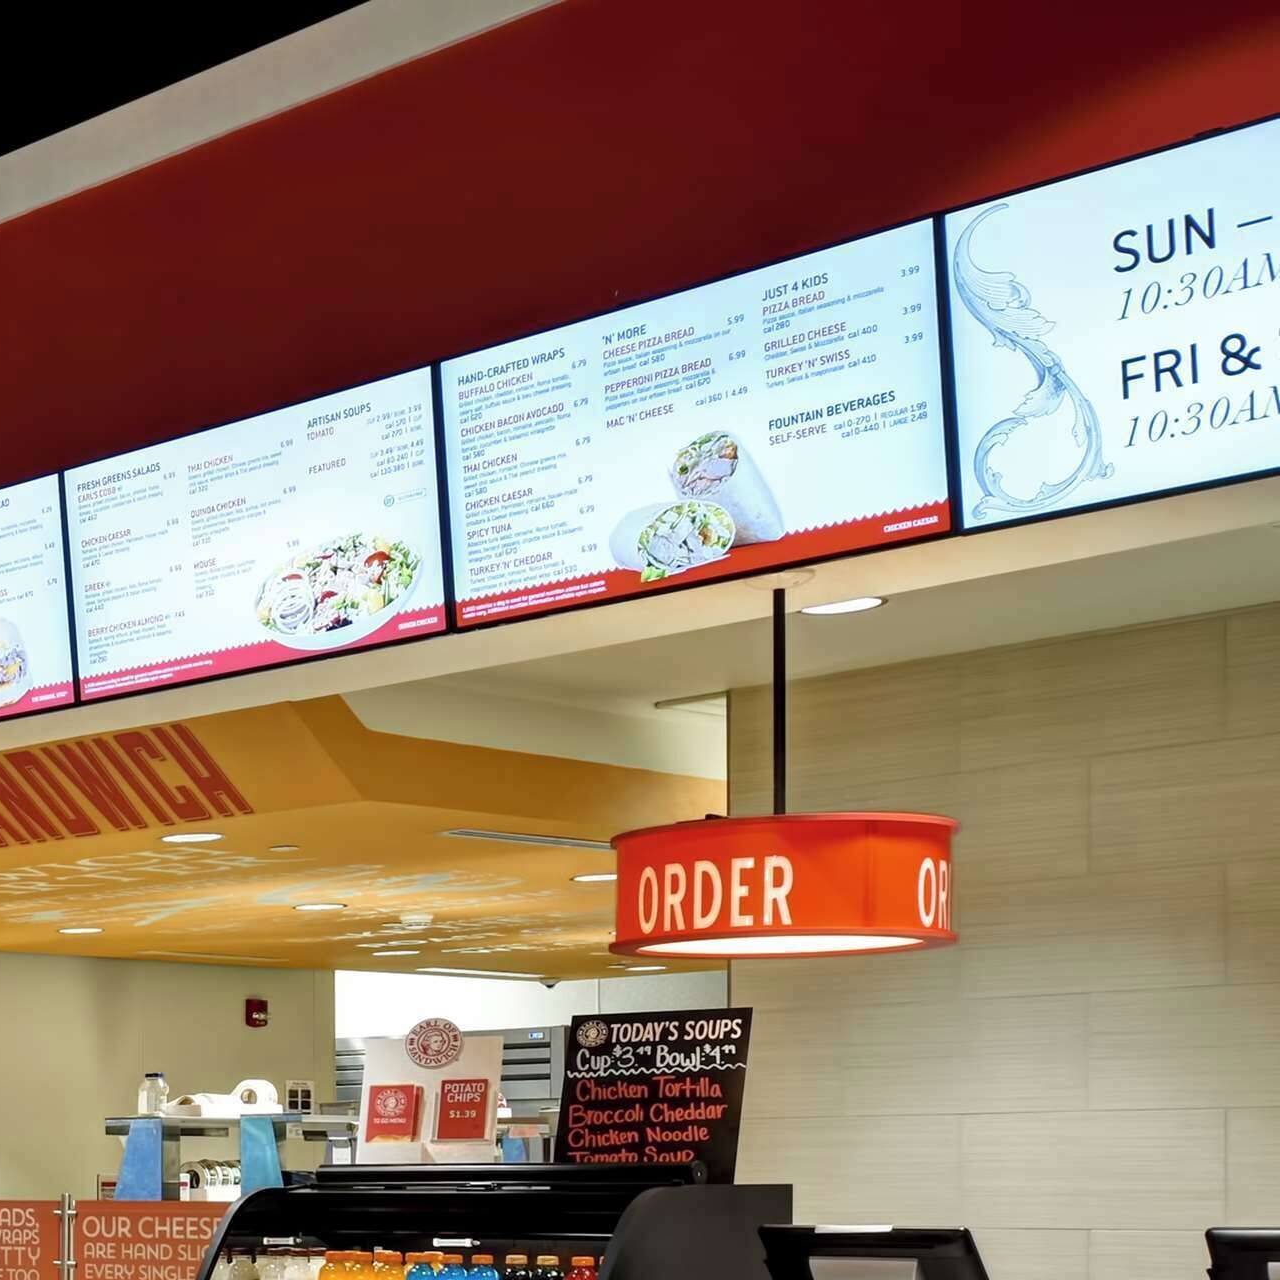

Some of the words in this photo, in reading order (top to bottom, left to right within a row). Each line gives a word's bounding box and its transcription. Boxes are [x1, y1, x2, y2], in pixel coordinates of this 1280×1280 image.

[1112, 206, 1216, 273] SUN
[762, 284, 788, 301] JUST
[791, 282, 799, 292] 4
[801, 272, 829, 290] KIDS
[762, 301, 789, 316] PIZZA
[791, 290, 825, 308] BREAD
[900, 265, 920, 277] 3.99
[902, 303, 922, 315] 3.99
[602, 333, 615, 345] 'N'
[617, 324, 647, 341] MORE
[764, 332, 806, 353] GRILLED
[807, 321, 847, 341] CHEESE
[861, 324, 878, 336] 400
[904, 332, 924, 344] 3.99
[602, 343, 638, 360] CHEESE
[638, 335, 663, 351] PIZZA
[664, 326, 695, 343] BREAD
[457, 358, 529, 387] HAND-CRAFTED
[531, 347, 566, 366] WRAPS
[604, 374, 654, 394] PEPPERONI
[654, 366, 680, 381] PIZZA
[681, 358, 712, 374] BREAD
[728, 350, 746, 361] 6.99
[765, 362, 803, 379] TURKEY
[819, 349, 850, 366] SWISS
[1121, 343, 1198, 400] FRI
[1220, 333, 1262, 376] &
[458, 382, 496, 401] BUFFALO
[496, 372, 534, 390] CHICKEN
[307, 410, 342, 430] ARTISAN
[343, 402, 372, 420] SOUPS
[606, 416, 625, 429] MAC
[638, 403, 674, 421] CHEESE
[768, 407, 823, 431] FOUNTAIN
[826, 390, 896, 417] BEVERAGES
[910, 401, 928, 414] 1.99
[460, 421, 496, 438] CHICKEN
[497, 412, 526, 428] BACON
[526, 402, 565, 420] AVOCADO
[307, 426, 335, 441] TOMATO
[769, 423, 827, 446] SELF-SERVE
[187, 461, 203, 473] THAI
[203, 454, 234, 470] CHICKEN
[308, 457, 347, 475] FEATURED
[463, 461, 480, 475] THAI
[482, 453, 518, 470] CHICKEN
[77, 479, 101, 493] FRESH
[102, 470, 131, 486] GREENS
[132, 462, 161, 478] SALADS
[465, 495, 500, 512] CHICKEN
[501, 487, 533, 504] CAESAR
[81, 535, 107, 549] CHICKEN
[108, 528, 132, 542] CAESAR
[466, 527, 490, 541] SPICY
[491, 523, 513, 537] TUNA
[470, 562, 501, 577] TURKEY
[513, 551, 553, 569] CHEDDAR
[638, 855, 794, 935] ORDER
[413, 1020, 441, 1036] EARL
[443, 1022, 457, 1034] OF
[610, 1021, 679, 1043] TODAY'S
[683, 1018, 742, 1041] SOUPS
[408, 1043, 459, 1065] SANDWICH
[444, 1082, 485, 1093] POTATO
[447, 1092, 481, 1103] CHIPS
[576, 1079, 648, 1101] Chicken
[651, 1075, 722, 1099] Tortilla
[449, 1109, 477, 1119] $1.39
[568, 1104, 644, 1128] Broccoli
[649, 1102, 728, 1123] Cheddar
[568, 1128, 639, 1148] Chicken
[646, 1125, 710, 1143] Noodle
[82, 1216, 132, 1239] OUR
[84, 1242, 109, 1259] ARE
[122, 1243, 173, 1261] HAND
[85, 1263, 134, 1280] EVERY
